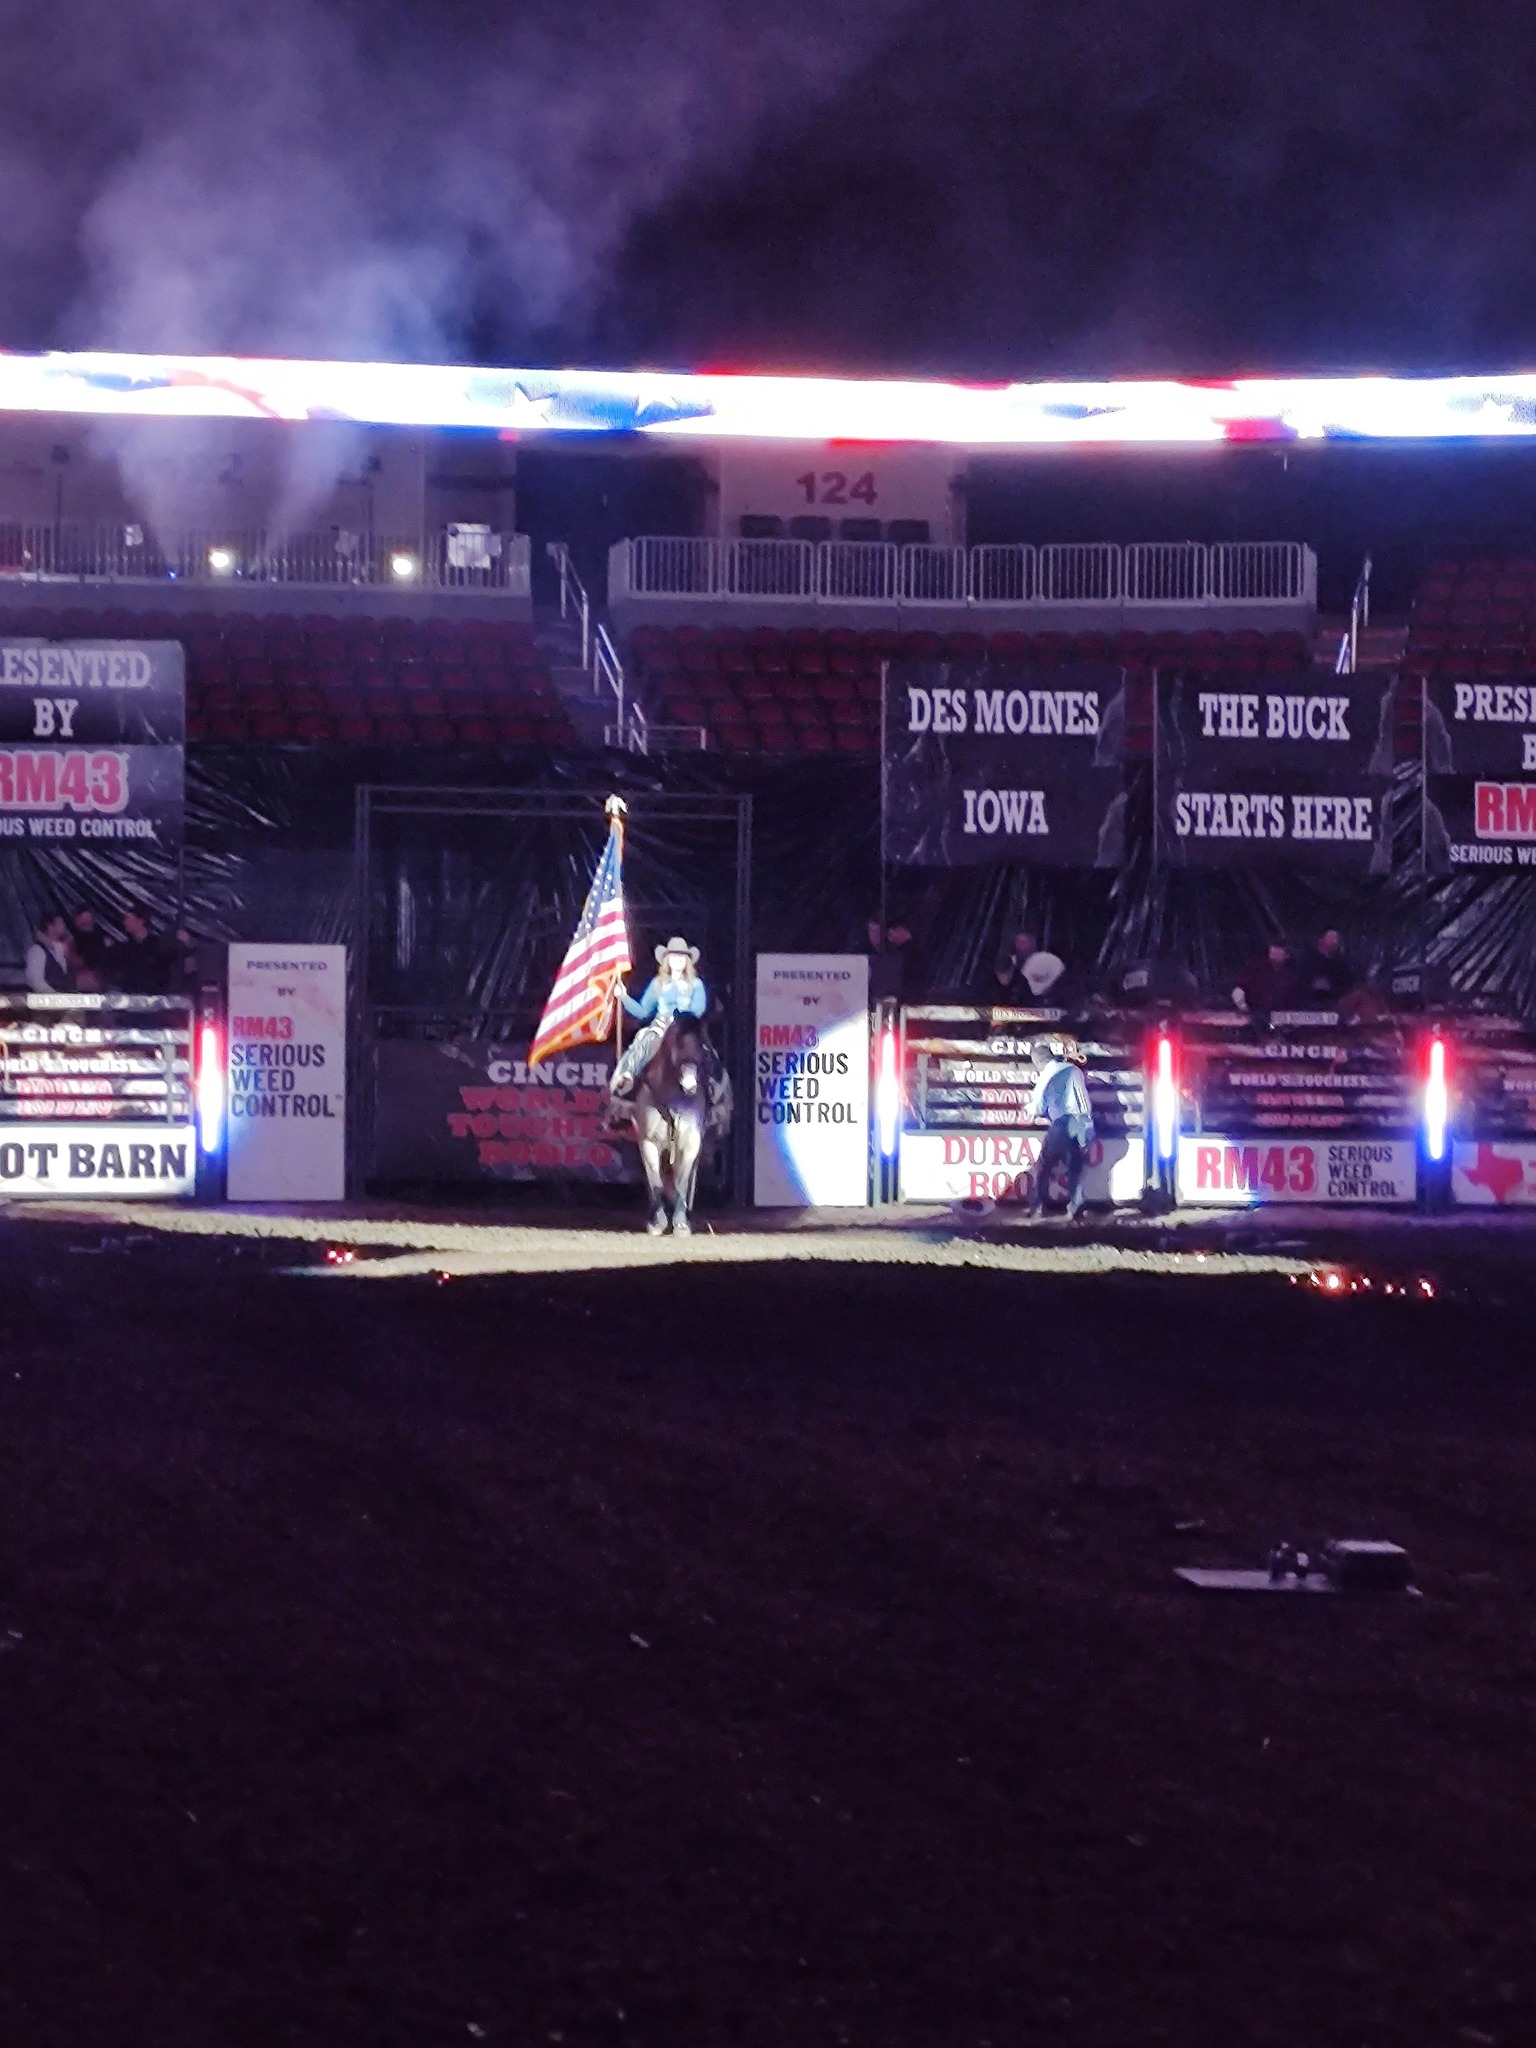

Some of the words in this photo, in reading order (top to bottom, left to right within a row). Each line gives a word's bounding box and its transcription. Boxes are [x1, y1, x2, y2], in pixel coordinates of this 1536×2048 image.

[796, 471, 878, 505] 124
[0, 648, 151, 687] ESENTED
[33, 698, 79, 736] BY
[907, 687, 967, 733] DES
[974, 688, 1100, 735] MOINES
[1198, 693, 1259, 737] THE
[1265, 696, 1350, 740] BUCK
[963, 789, 1049, 834] IOWA
[1175, 793, 1284, 838] STARTS
[1291, 796, 1373, 841] HERE
[28, 818, 75, 837] WEED
[81, 819, 154, 838] CONTROL
[1450, 845, 1513, 864] SERIOUS
[247, 961, 328, 971] PRESENTED
[773, 970, 851, 981] PRESENTED
[277, 987, 297, 997] BY
[802, 996, 821, 1006] BY
[21, 1029, 102, 1043] CINCH
[232, 1015, 293, 1040] RM43
[759, 1024, 819, 1048] RM43
[231, 1043, 325, 1067] SERIOUS
[990, 1041, 1064, 1056] CINH
[1264, 1045, 1339, 1059] CINCH
[487, 1060, 608, 1085] CINCH
[758, 1052, 849, 1075] SERIOUS
[231, 1069, 295, 1092] WEED
[952, 1069, 1017, 1084] WORLD'S
[758, 1077, 819, 1100] WEED
[231, 1094, 336, 1117] CONTROL
[757, 1102, 858, 1125] CONTROL
[68, 1143, 187, 1179] BARN
[478, 1140, 614, 1167] RODEO
[1328, 1146, 1393, 1162] SERIOUS
[1196, 1146, 1315, 1192] RM43
[1328, 1164, 1374, 1180] WEED
[1328, 1180, 1399, 1198] CONTROL
